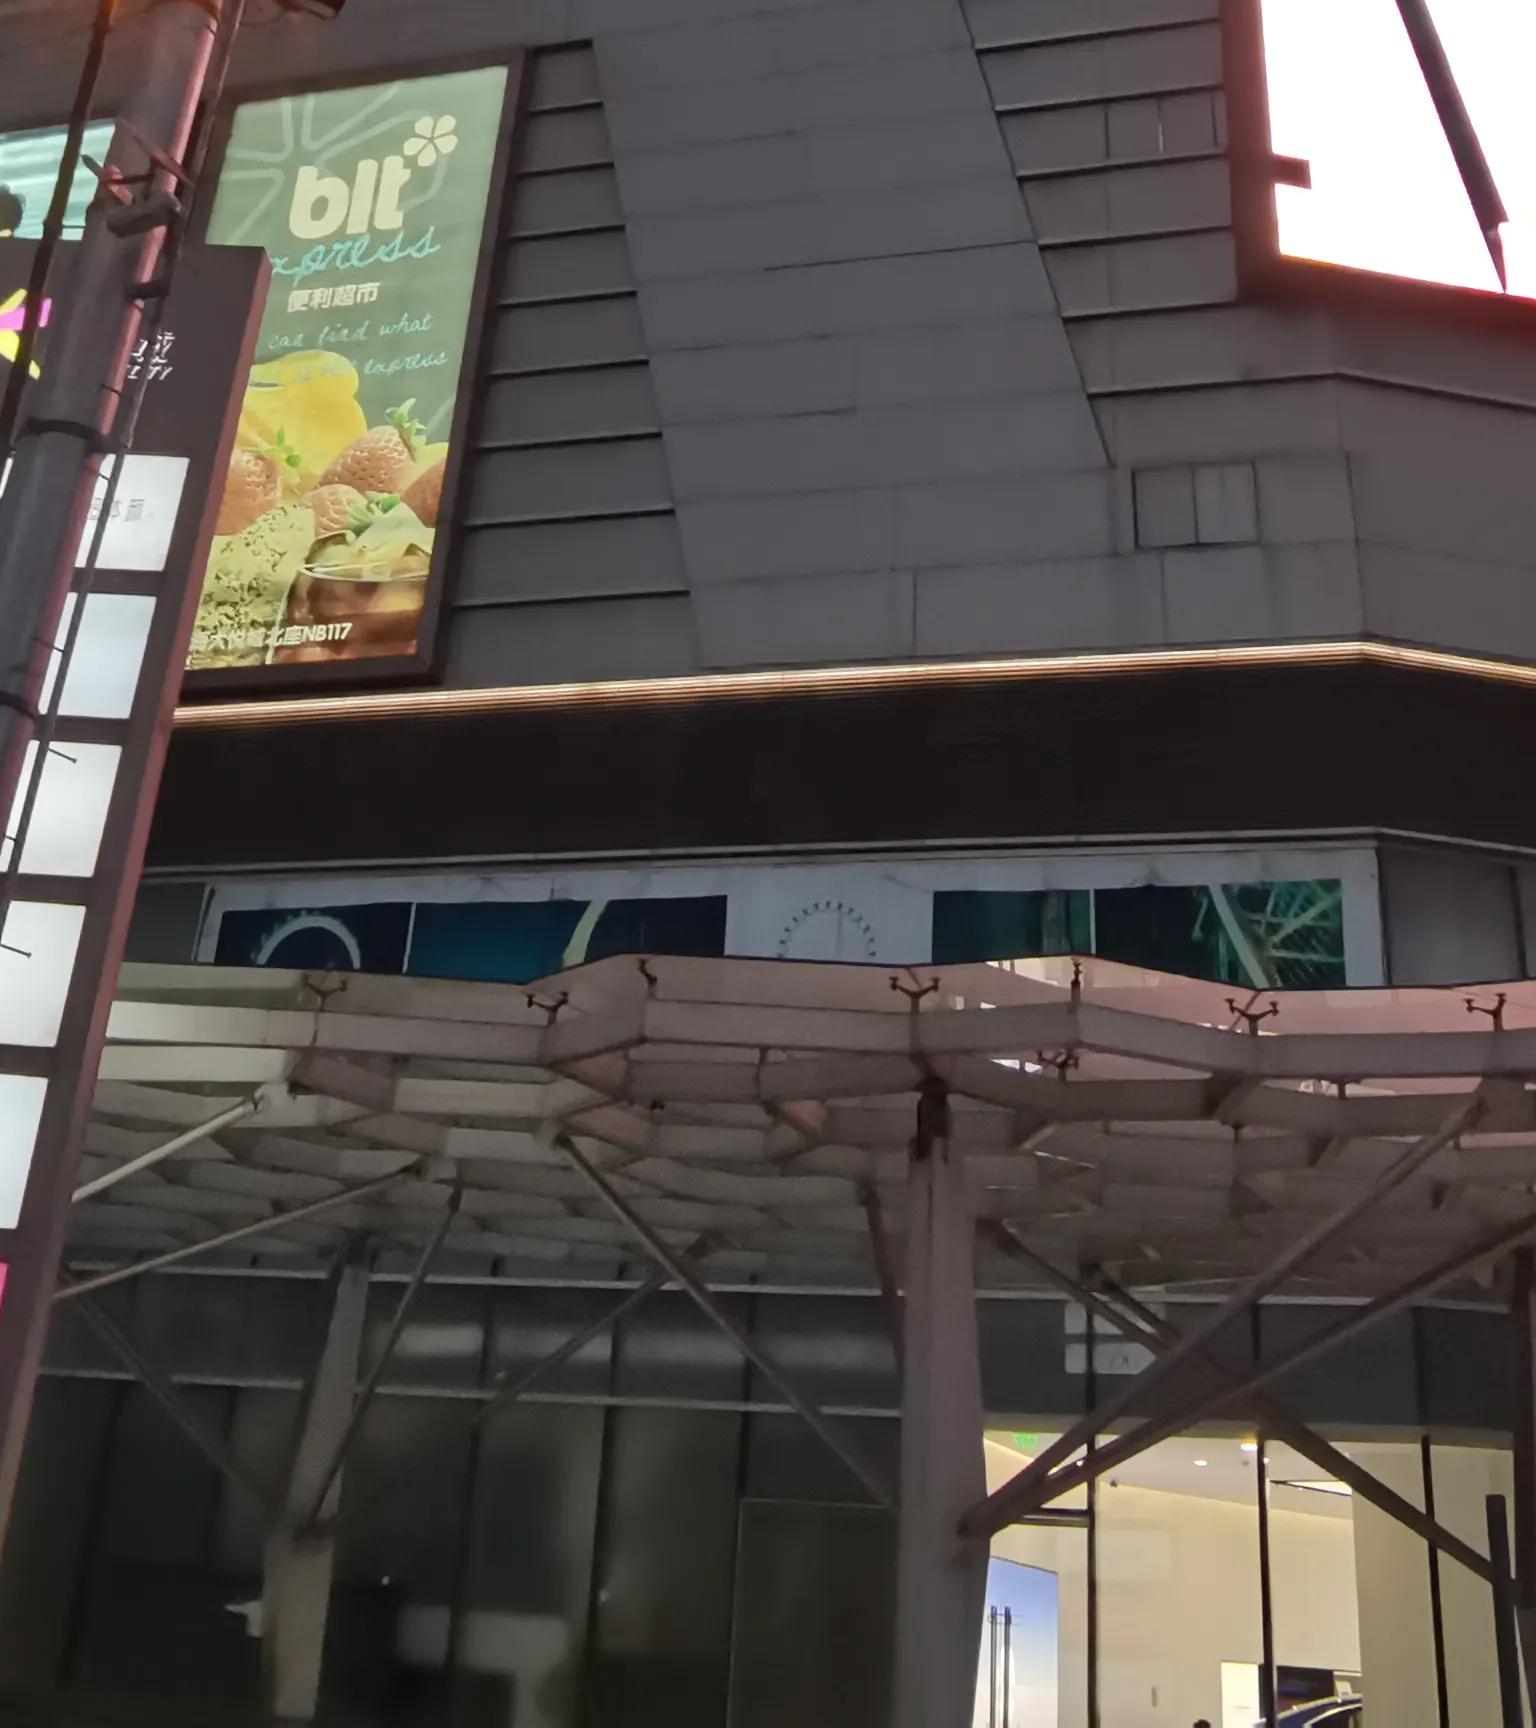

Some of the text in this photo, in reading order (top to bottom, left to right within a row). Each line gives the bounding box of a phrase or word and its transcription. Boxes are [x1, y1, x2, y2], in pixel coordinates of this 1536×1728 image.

[269, 226, 441, 287] xpress
[287, 281, 383, 313] 便利超市
[379, 312, 434, 337] what
